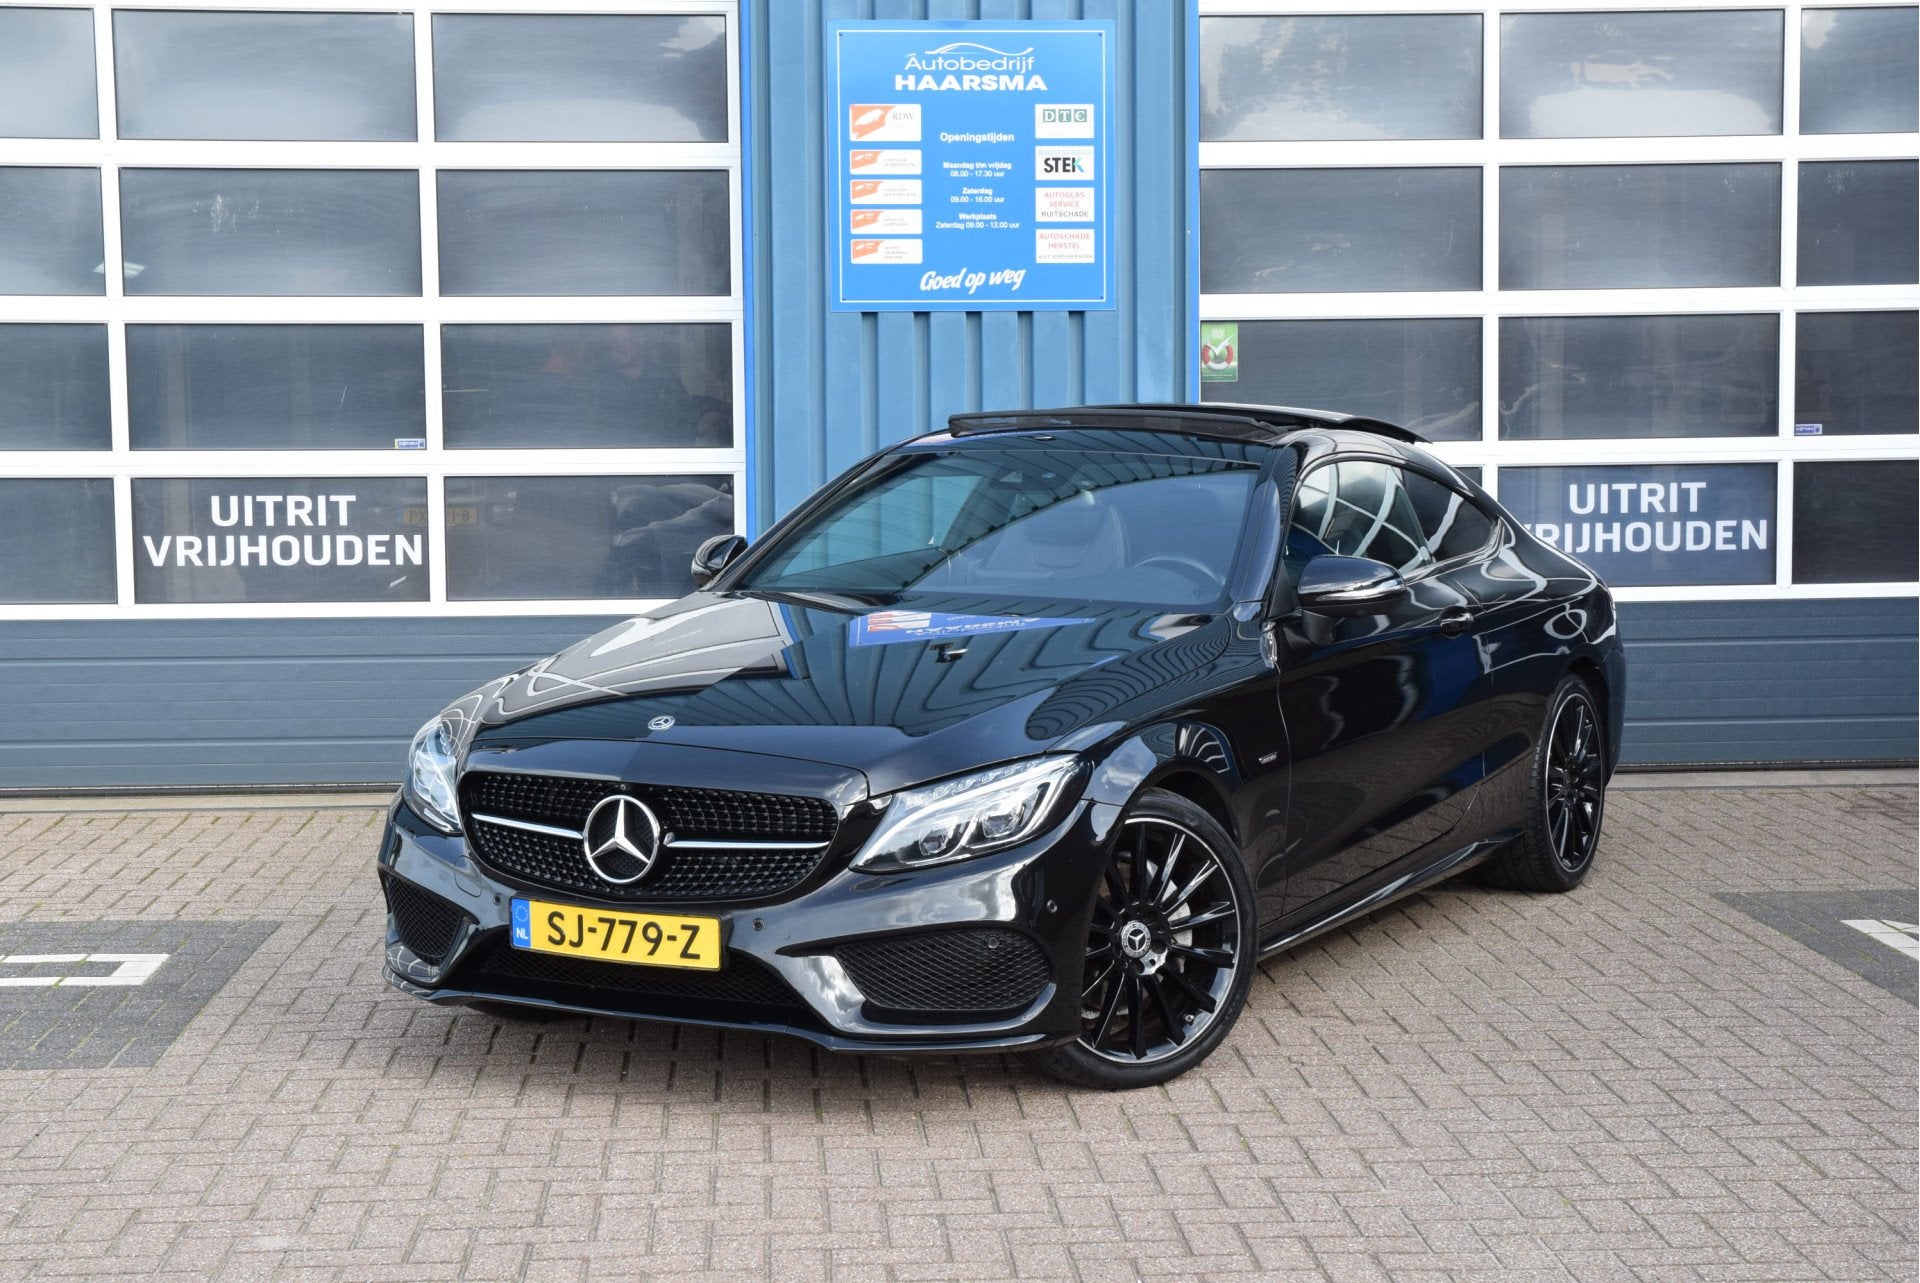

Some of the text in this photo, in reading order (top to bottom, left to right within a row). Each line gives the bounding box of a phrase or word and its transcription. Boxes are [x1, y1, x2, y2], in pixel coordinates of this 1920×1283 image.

[895, 75, 1048, 91] HAARSMA
[1043, 109, 1087, 122] DTC
[940, 132, 1015, 143] Openingstijden
[943, 162, 974, 170] Maandag
[988, 162, 1012, 170] vrijdag
[1044, 157, 1085, 173] STEK
[962, 187, 993, 195] Zaterdag
[959, 213, 997, 221] Werkplaats
[935, 222, 965, 230] Zaterdag
[920, 267, 1026, 295] Goed op weg
[1569, 482, 1707, 515] UITRIT
[210, 495, 356, 527] UITRIT
[1524, 519, 1768, 553] RIJHOUDEN
[142, 534, 423, 567] VRIJHOUDEN
[516, 928, 529, 940] NL
[547, 911, 701, 960] SJ-779-Z
